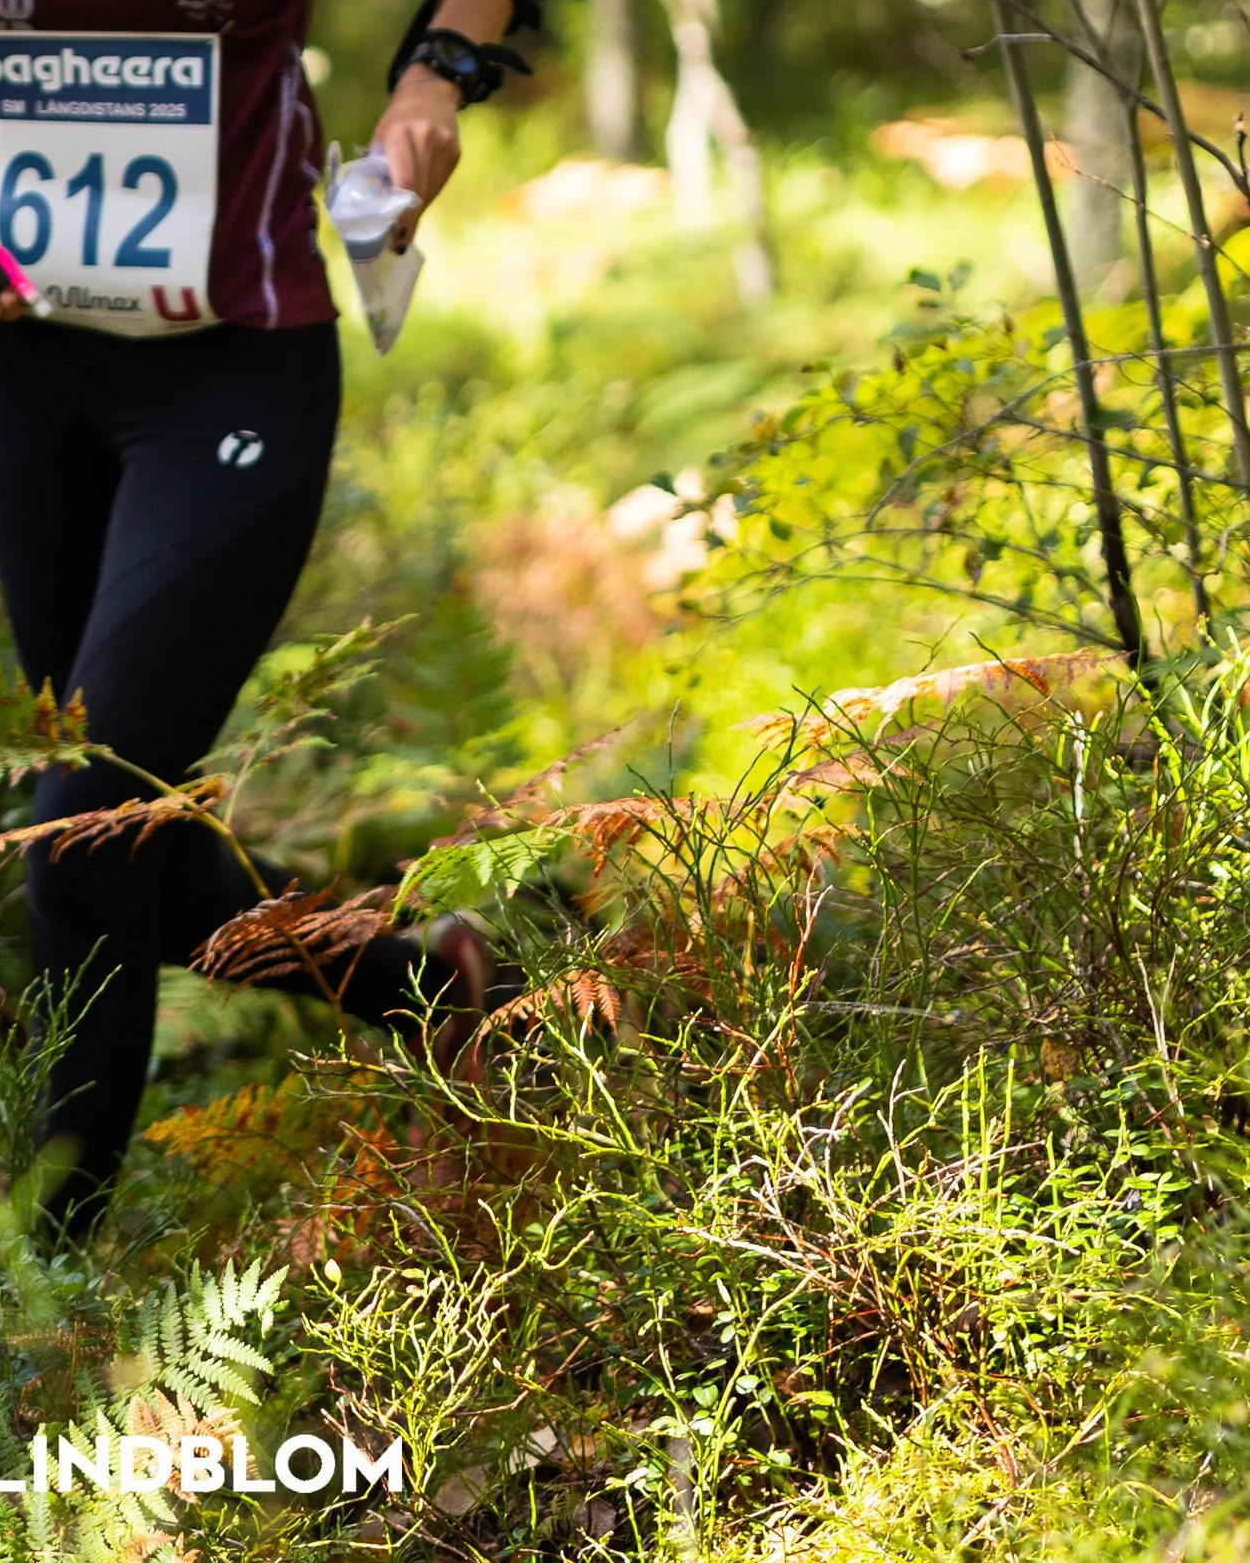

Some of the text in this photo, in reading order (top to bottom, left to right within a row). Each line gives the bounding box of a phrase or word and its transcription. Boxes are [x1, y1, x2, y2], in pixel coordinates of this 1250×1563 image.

[1, 98, 187, 118] SM LÅNGDISTANS 2025
